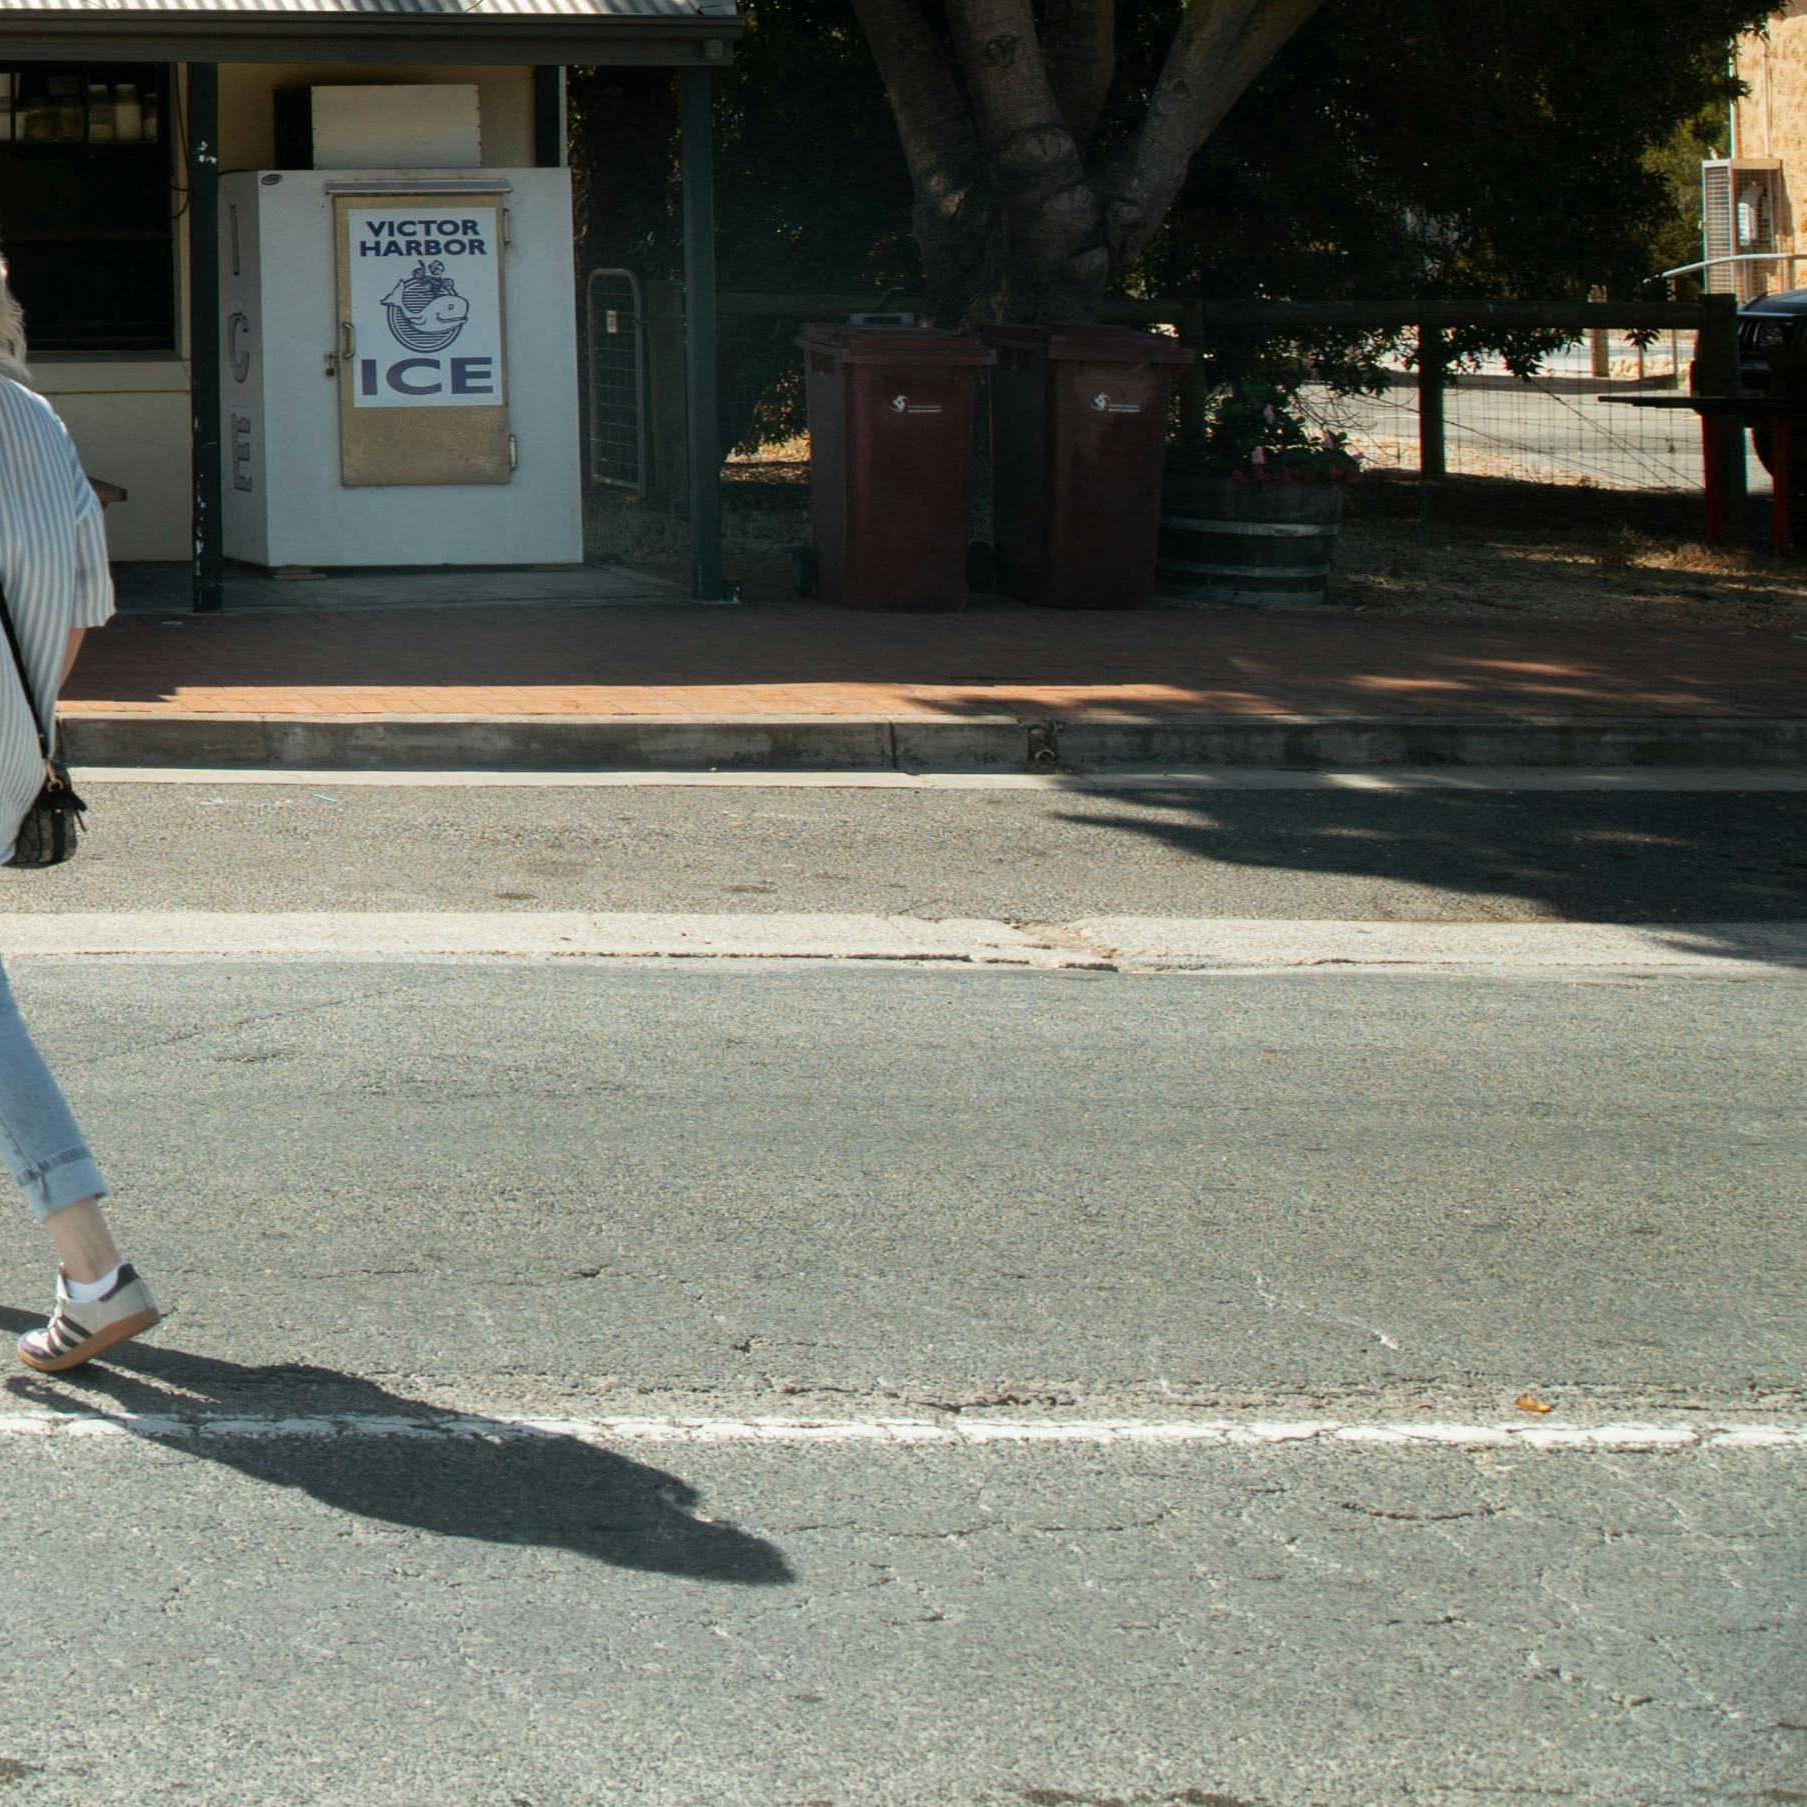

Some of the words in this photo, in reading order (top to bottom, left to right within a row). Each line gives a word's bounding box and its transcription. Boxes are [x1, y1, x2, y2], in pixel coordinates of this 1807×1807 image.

[366, 219, 480, 237] VICTOR
[360, 239, 487, 257] HARBOR
[361, 357, 493, 395] ICE
